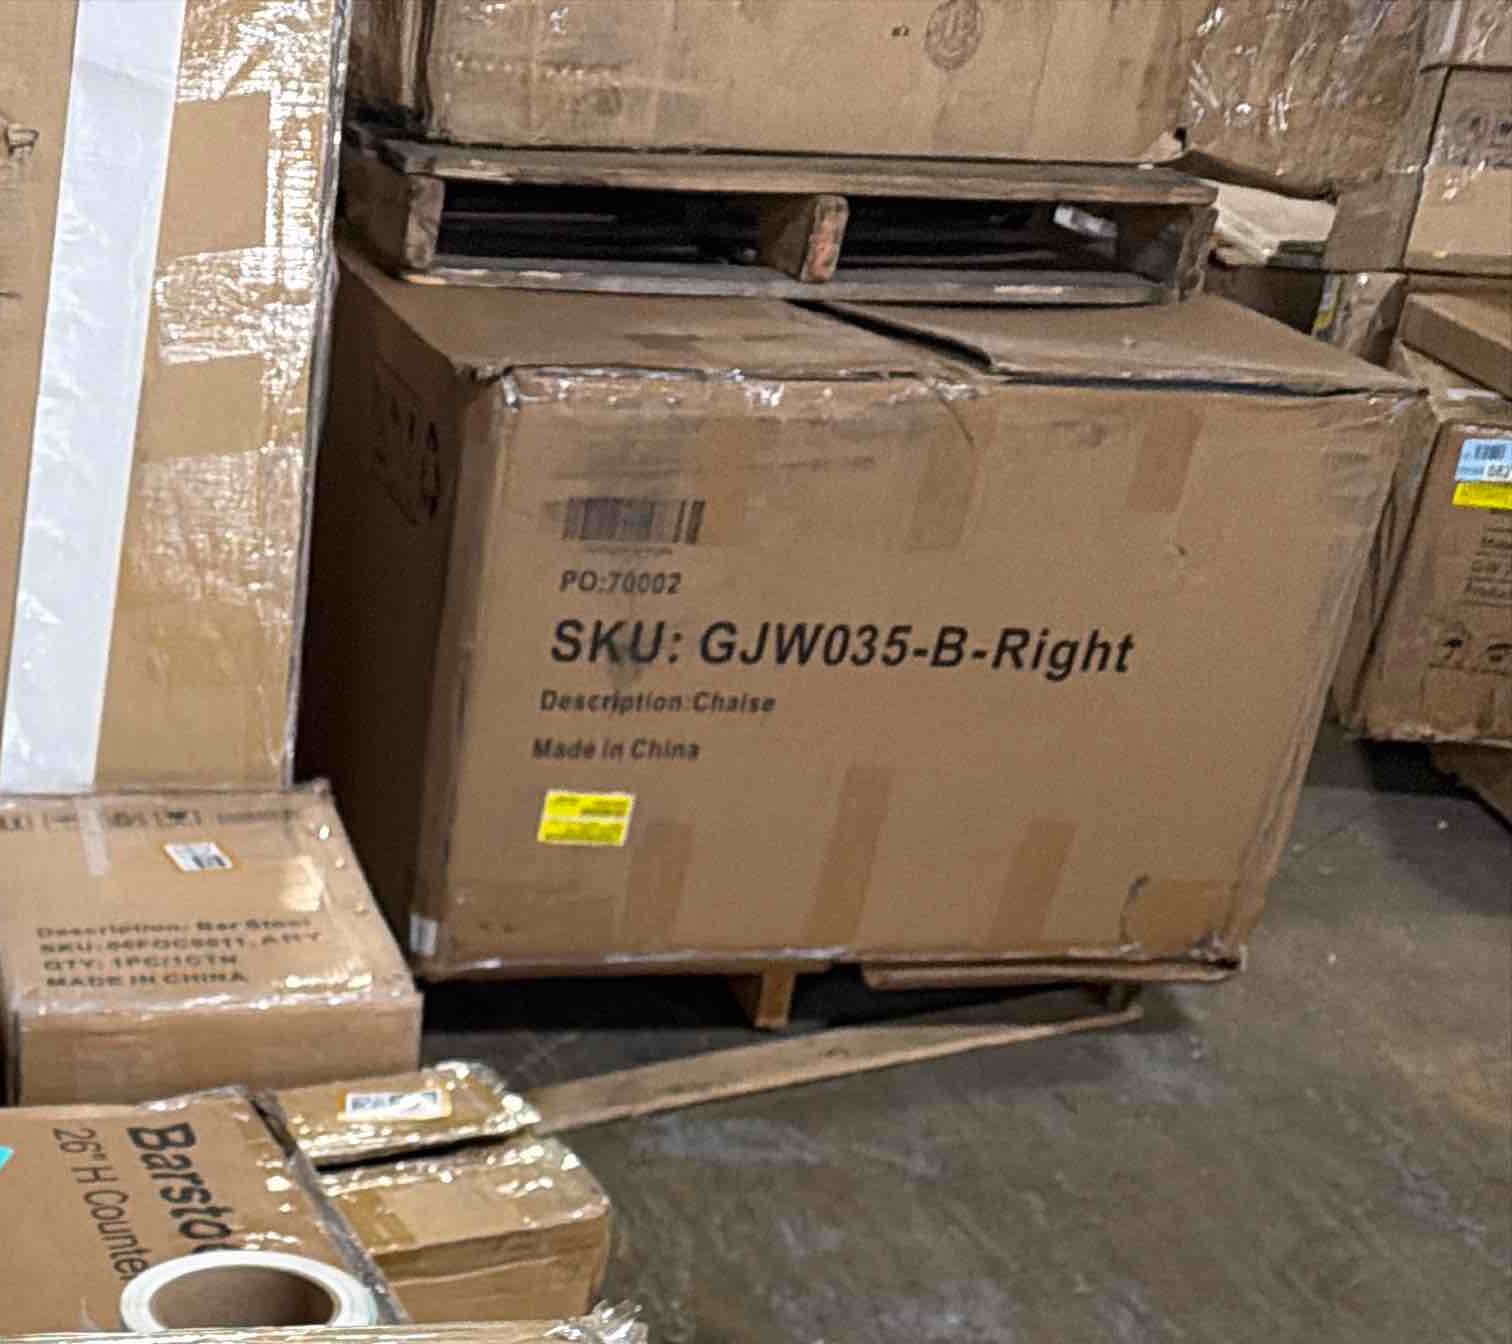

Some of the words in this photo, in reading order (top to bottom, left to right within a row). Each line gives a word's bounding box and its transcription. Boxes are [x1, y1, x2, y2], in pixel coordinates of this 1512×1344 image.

[559, 569, 683, 595] PO:70002
[551, 618, 684, 666] SKU:
[700, 620, 1136, 683] GJW035-B-Right
[532, 737, 596, 760] Made
[601, 737, 625, 761] in
[631, 737, 700, 761] China
[45, 974, 122, 988] MADE
[129, 973, 156, 986] IN
[162, 970, 248, 985] CHINA
